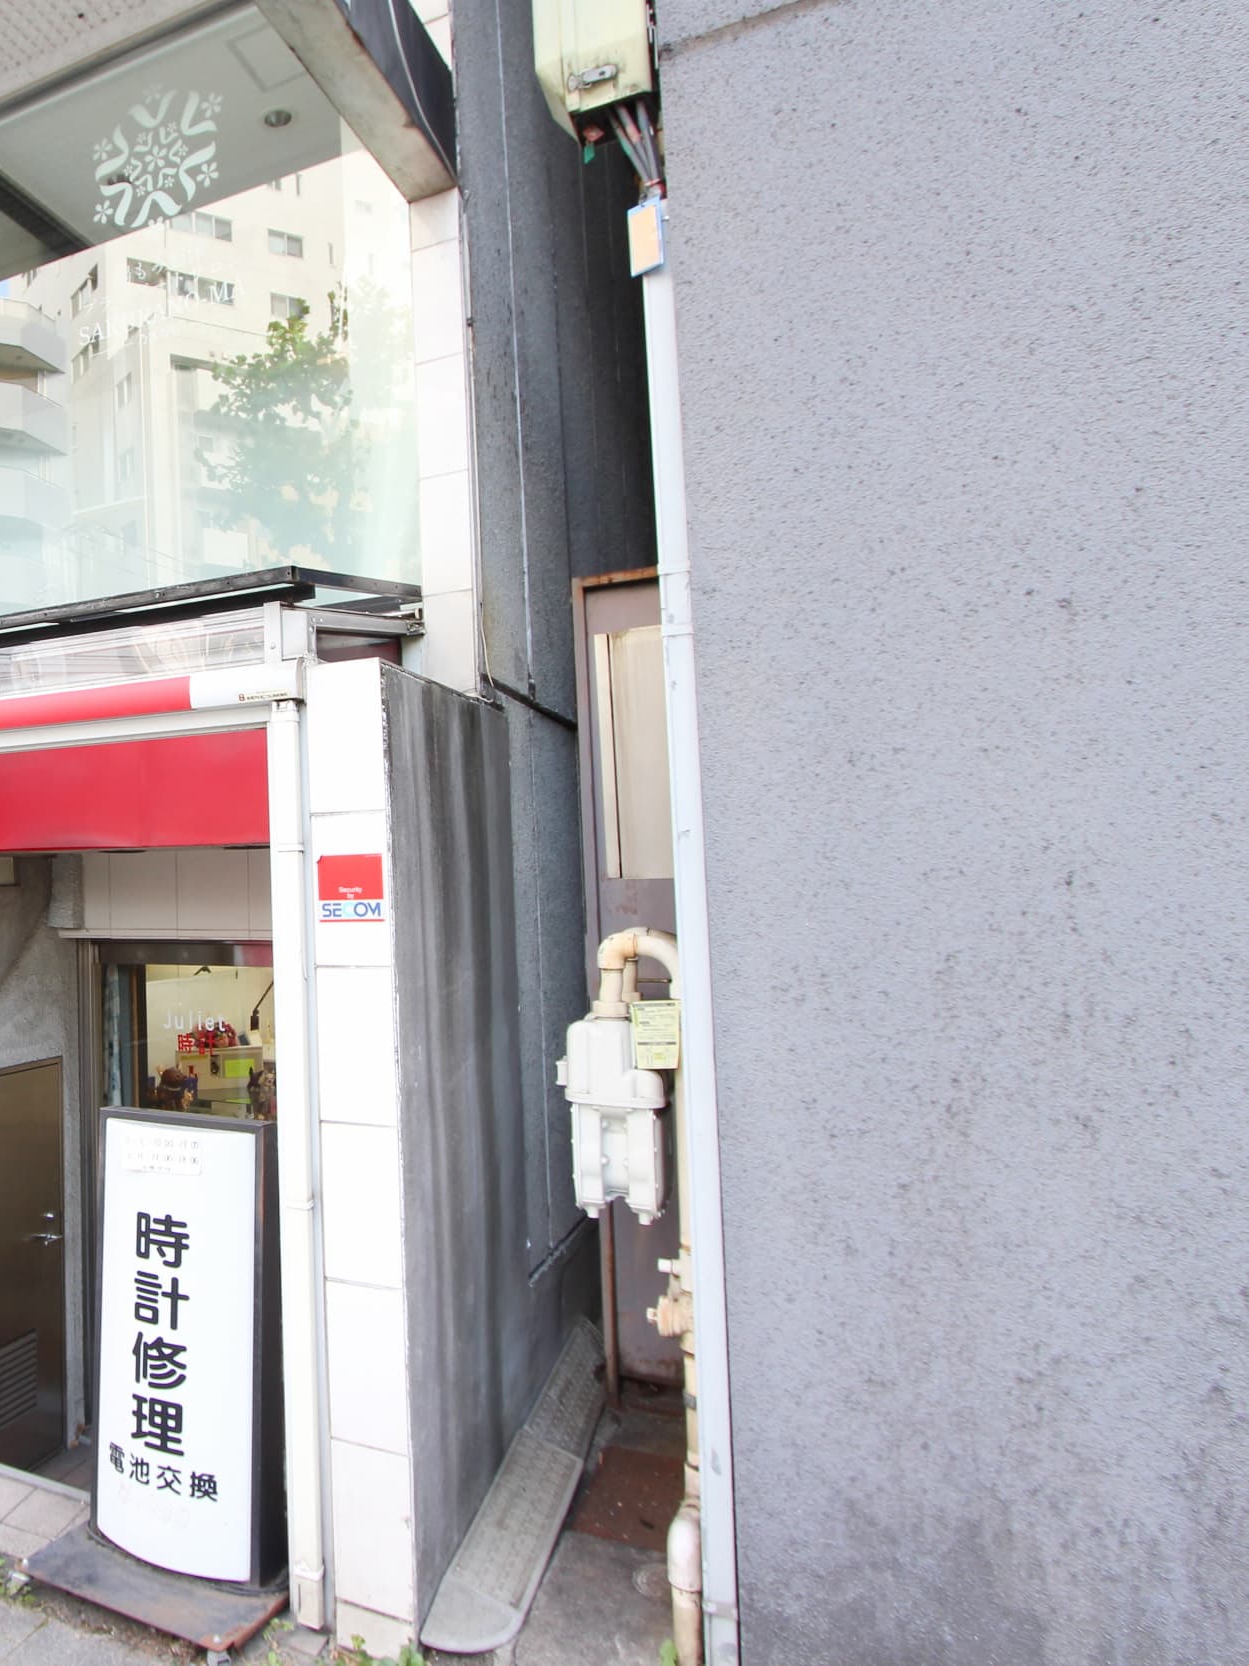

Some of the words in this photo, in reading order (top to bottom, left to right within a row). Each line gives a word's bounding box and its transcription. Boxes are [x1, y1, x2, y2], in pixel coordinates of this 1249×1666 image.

[338, 886, 363, 895] Security
[322, 902, 381, 918] SECOM
[163, 1008, 226, 1032] Juliet
[131, 1211, 190, 1456] 時計修理
[109, 1441, 219, 1502] 電池交換
